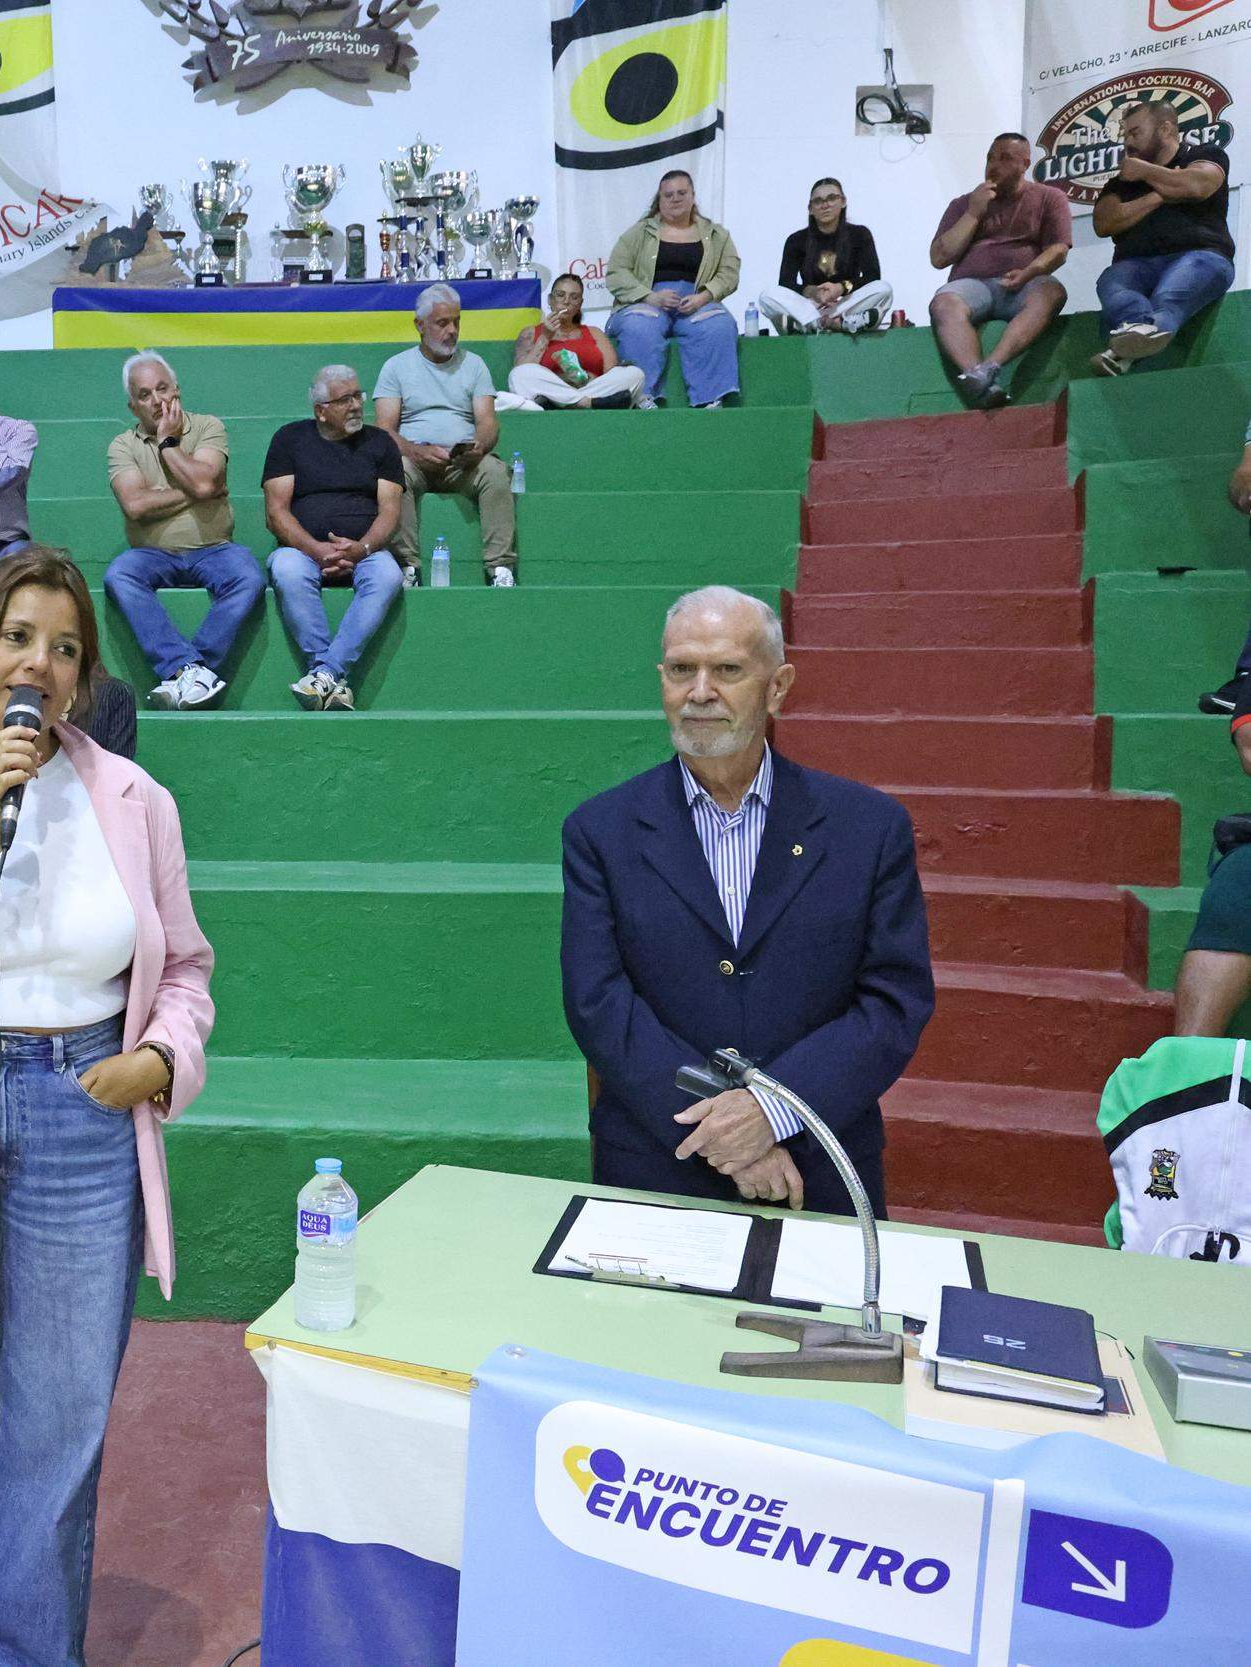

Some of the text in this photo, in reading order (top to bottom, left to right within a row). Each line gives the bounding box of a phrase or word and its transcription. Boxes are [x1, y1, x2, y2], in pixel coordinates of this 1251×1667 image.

[226, 30, 361, 70] 75 Aniversario
[307, 43, 380, 57] 1934-2009
[1039, 71, 1051, 81] C/
[1109, 53, 1121, 64] 23
[1130, 35, 1188, 58] ARRECIFE
[1051, 75, 1216, 132] INTERNATIONAL COCKTAIL BAR
[1071, 123, 1111, 148] The
[28, 218, 73, 252] Islands
[302, 1220, 327, 1231] DEUS
[303, 1213, 328, 1225] AQUA
[633, 1468, 788, 1518] PUNTO DE
[585, 1483, 951, 1594] ENCUENTRO
